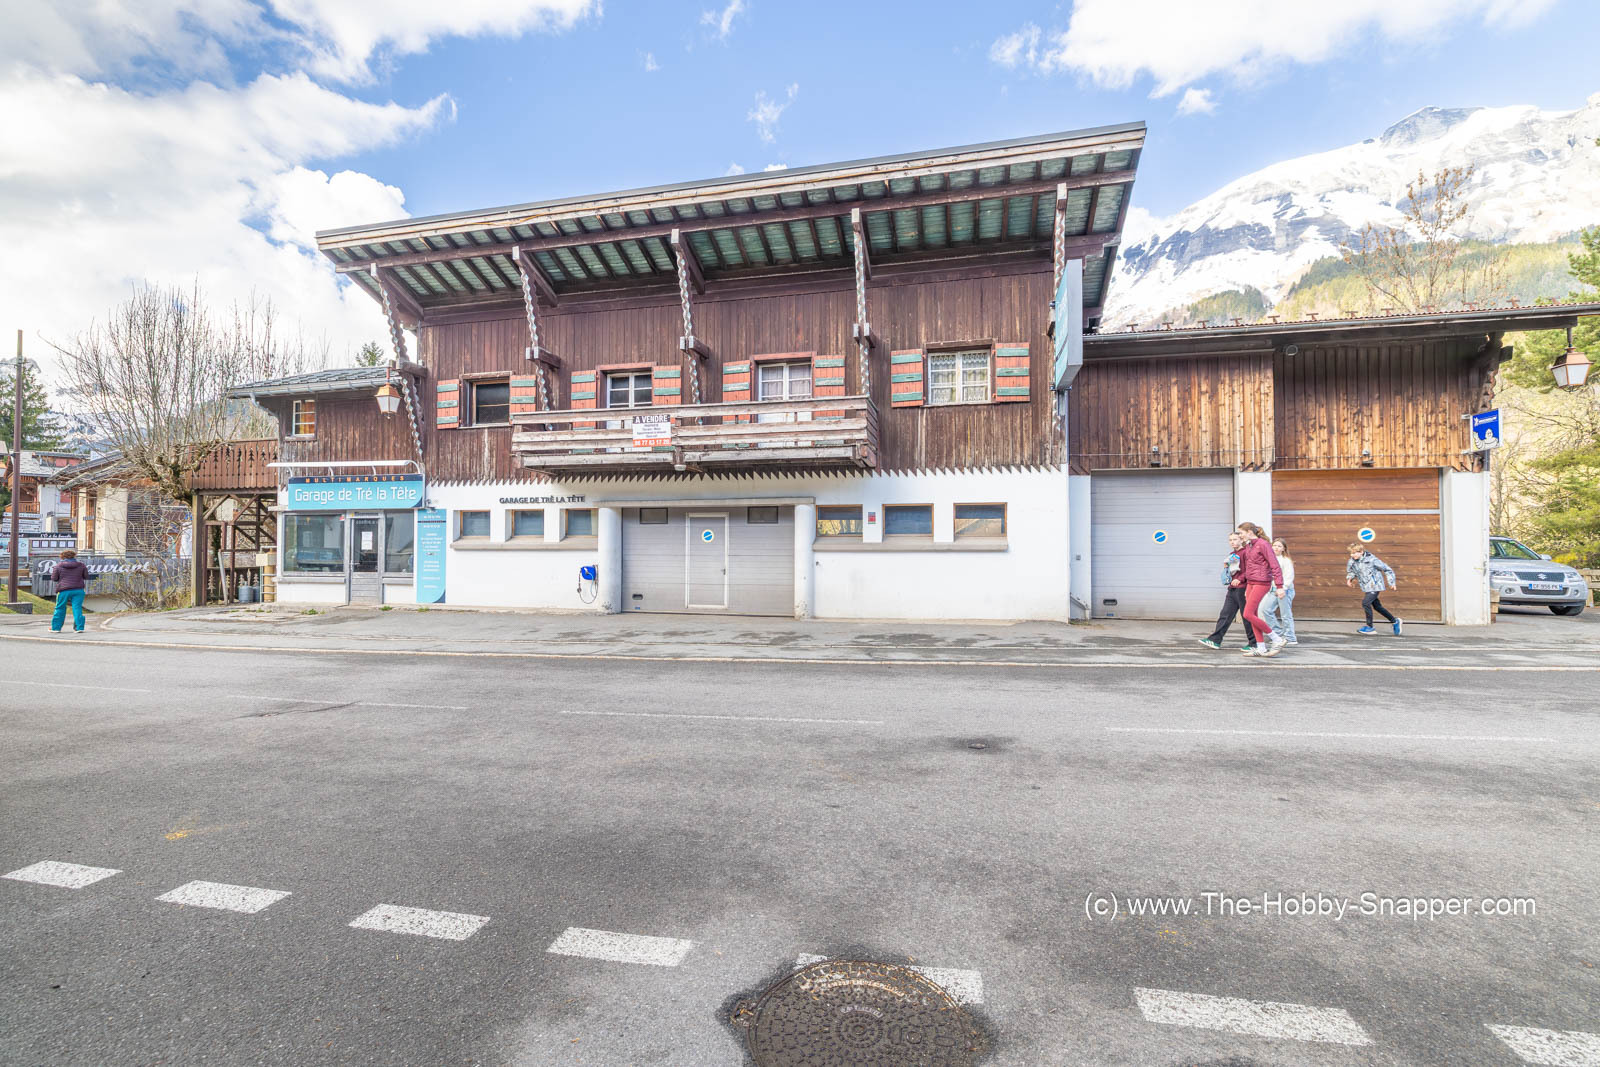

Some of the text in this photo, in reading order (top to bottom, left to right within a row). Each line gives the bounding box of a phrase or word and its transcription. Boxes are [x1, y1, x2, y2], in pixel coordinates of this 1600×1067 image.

[641, 415, 667, 423] VENDRE
[295, 486, 417, 504] Garage de Tré la Tête
[567, 494, 586, 503] TÊTE
[38, 560, 150, 574] Raurant
